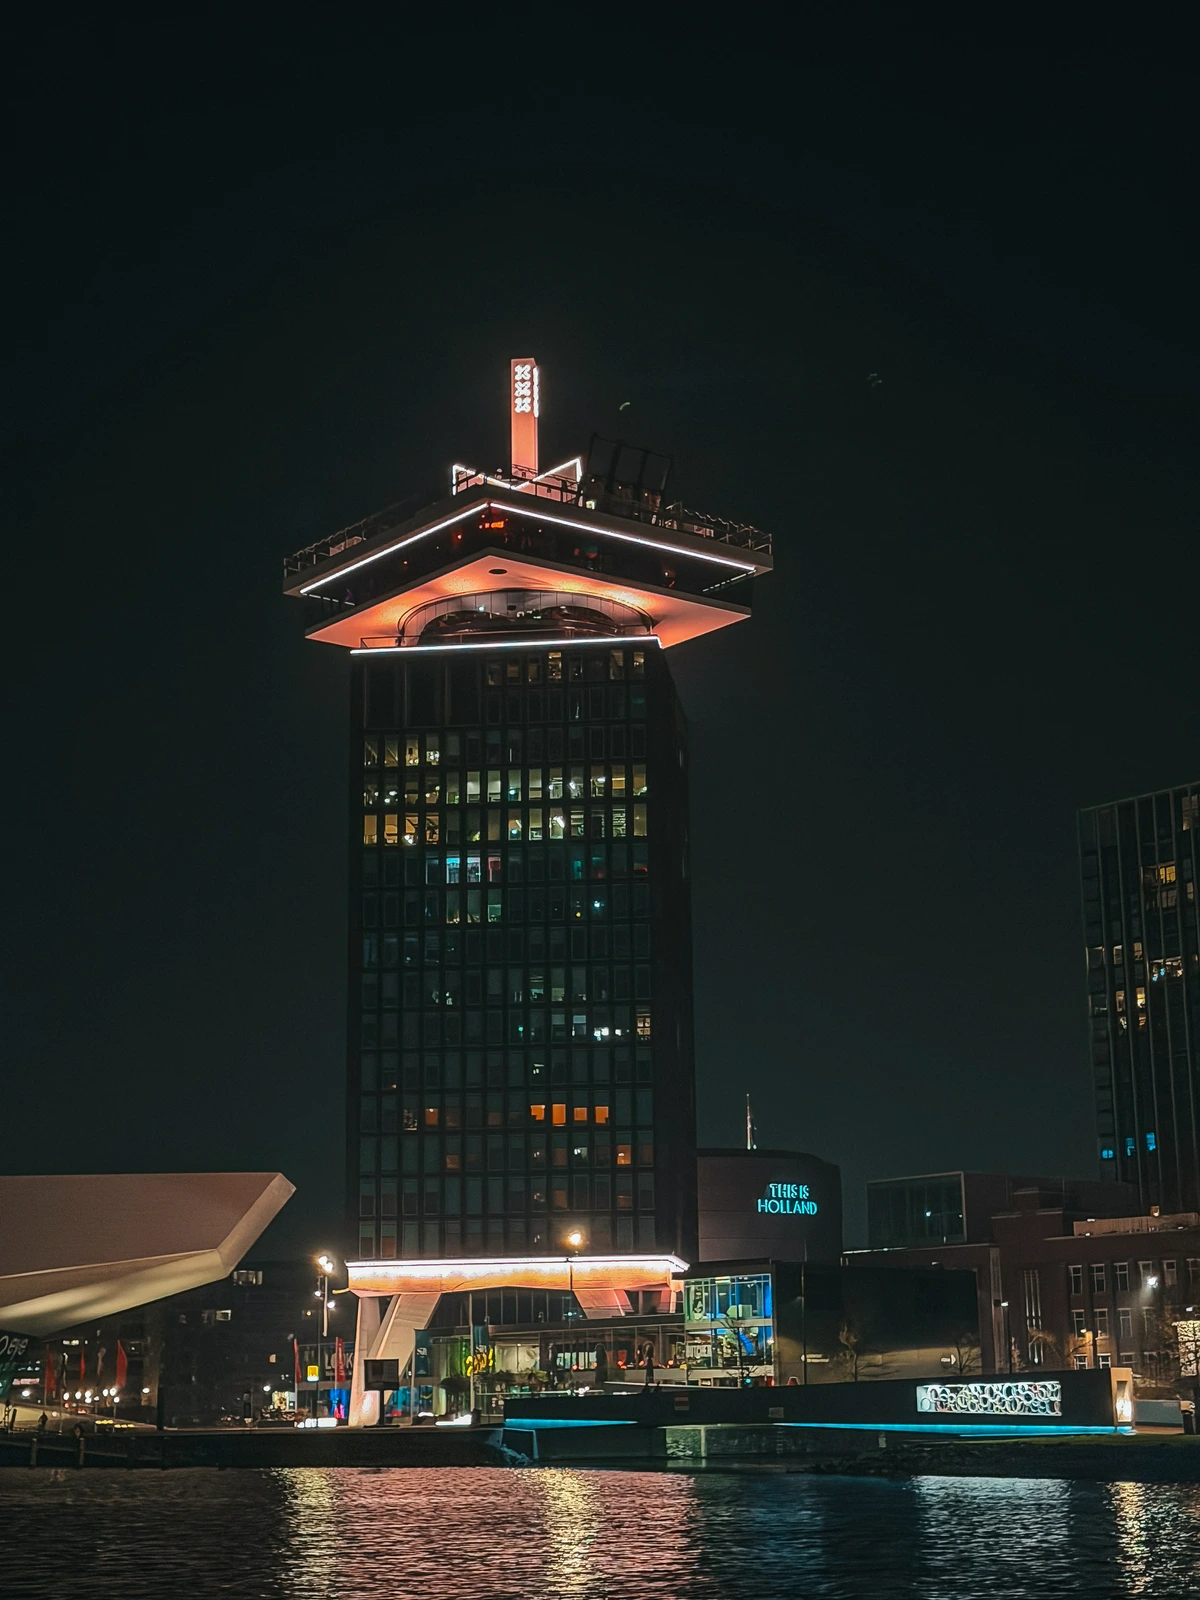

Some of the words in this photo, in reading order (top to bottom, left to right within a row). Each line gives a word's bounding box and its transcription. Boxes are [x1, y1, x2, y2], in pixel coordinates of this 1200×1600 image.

[769, 1183, 798, 1199] THIS
[799, 1184, 810, 1200] IS
[757, 1199, 818, 1215] HOLLAND
